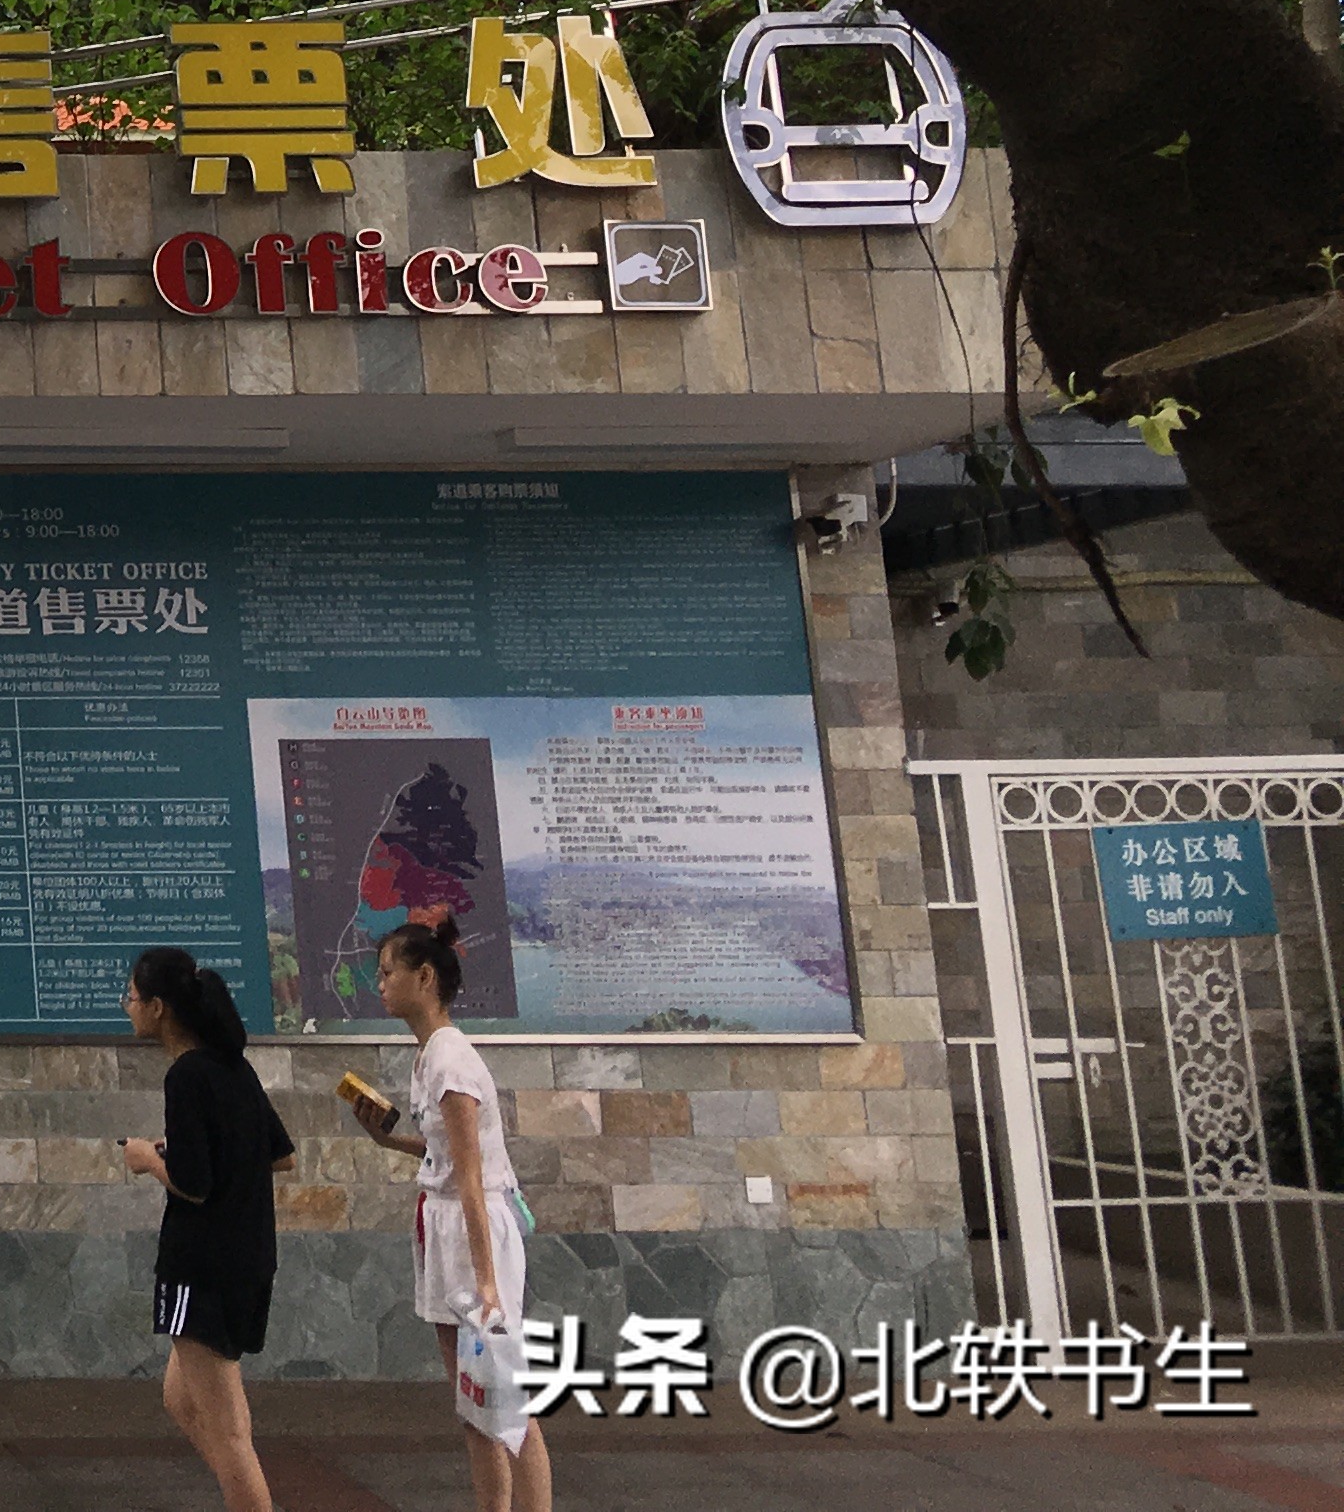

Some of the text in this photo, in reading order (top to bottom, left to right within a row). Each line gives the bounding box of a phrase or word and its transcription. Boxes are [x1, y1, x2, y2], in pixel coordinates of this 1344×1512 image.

[153, 227, 551, 315] Office
[24, 561, 113, 582] TICKET
[122, 560, 209, 581] OFFICE
[1121, 834, 1244, 867] 办公区域
[1126, 871, 1250, 902] 非请勿入
[1145, 906, 1234, 927] Staff only
